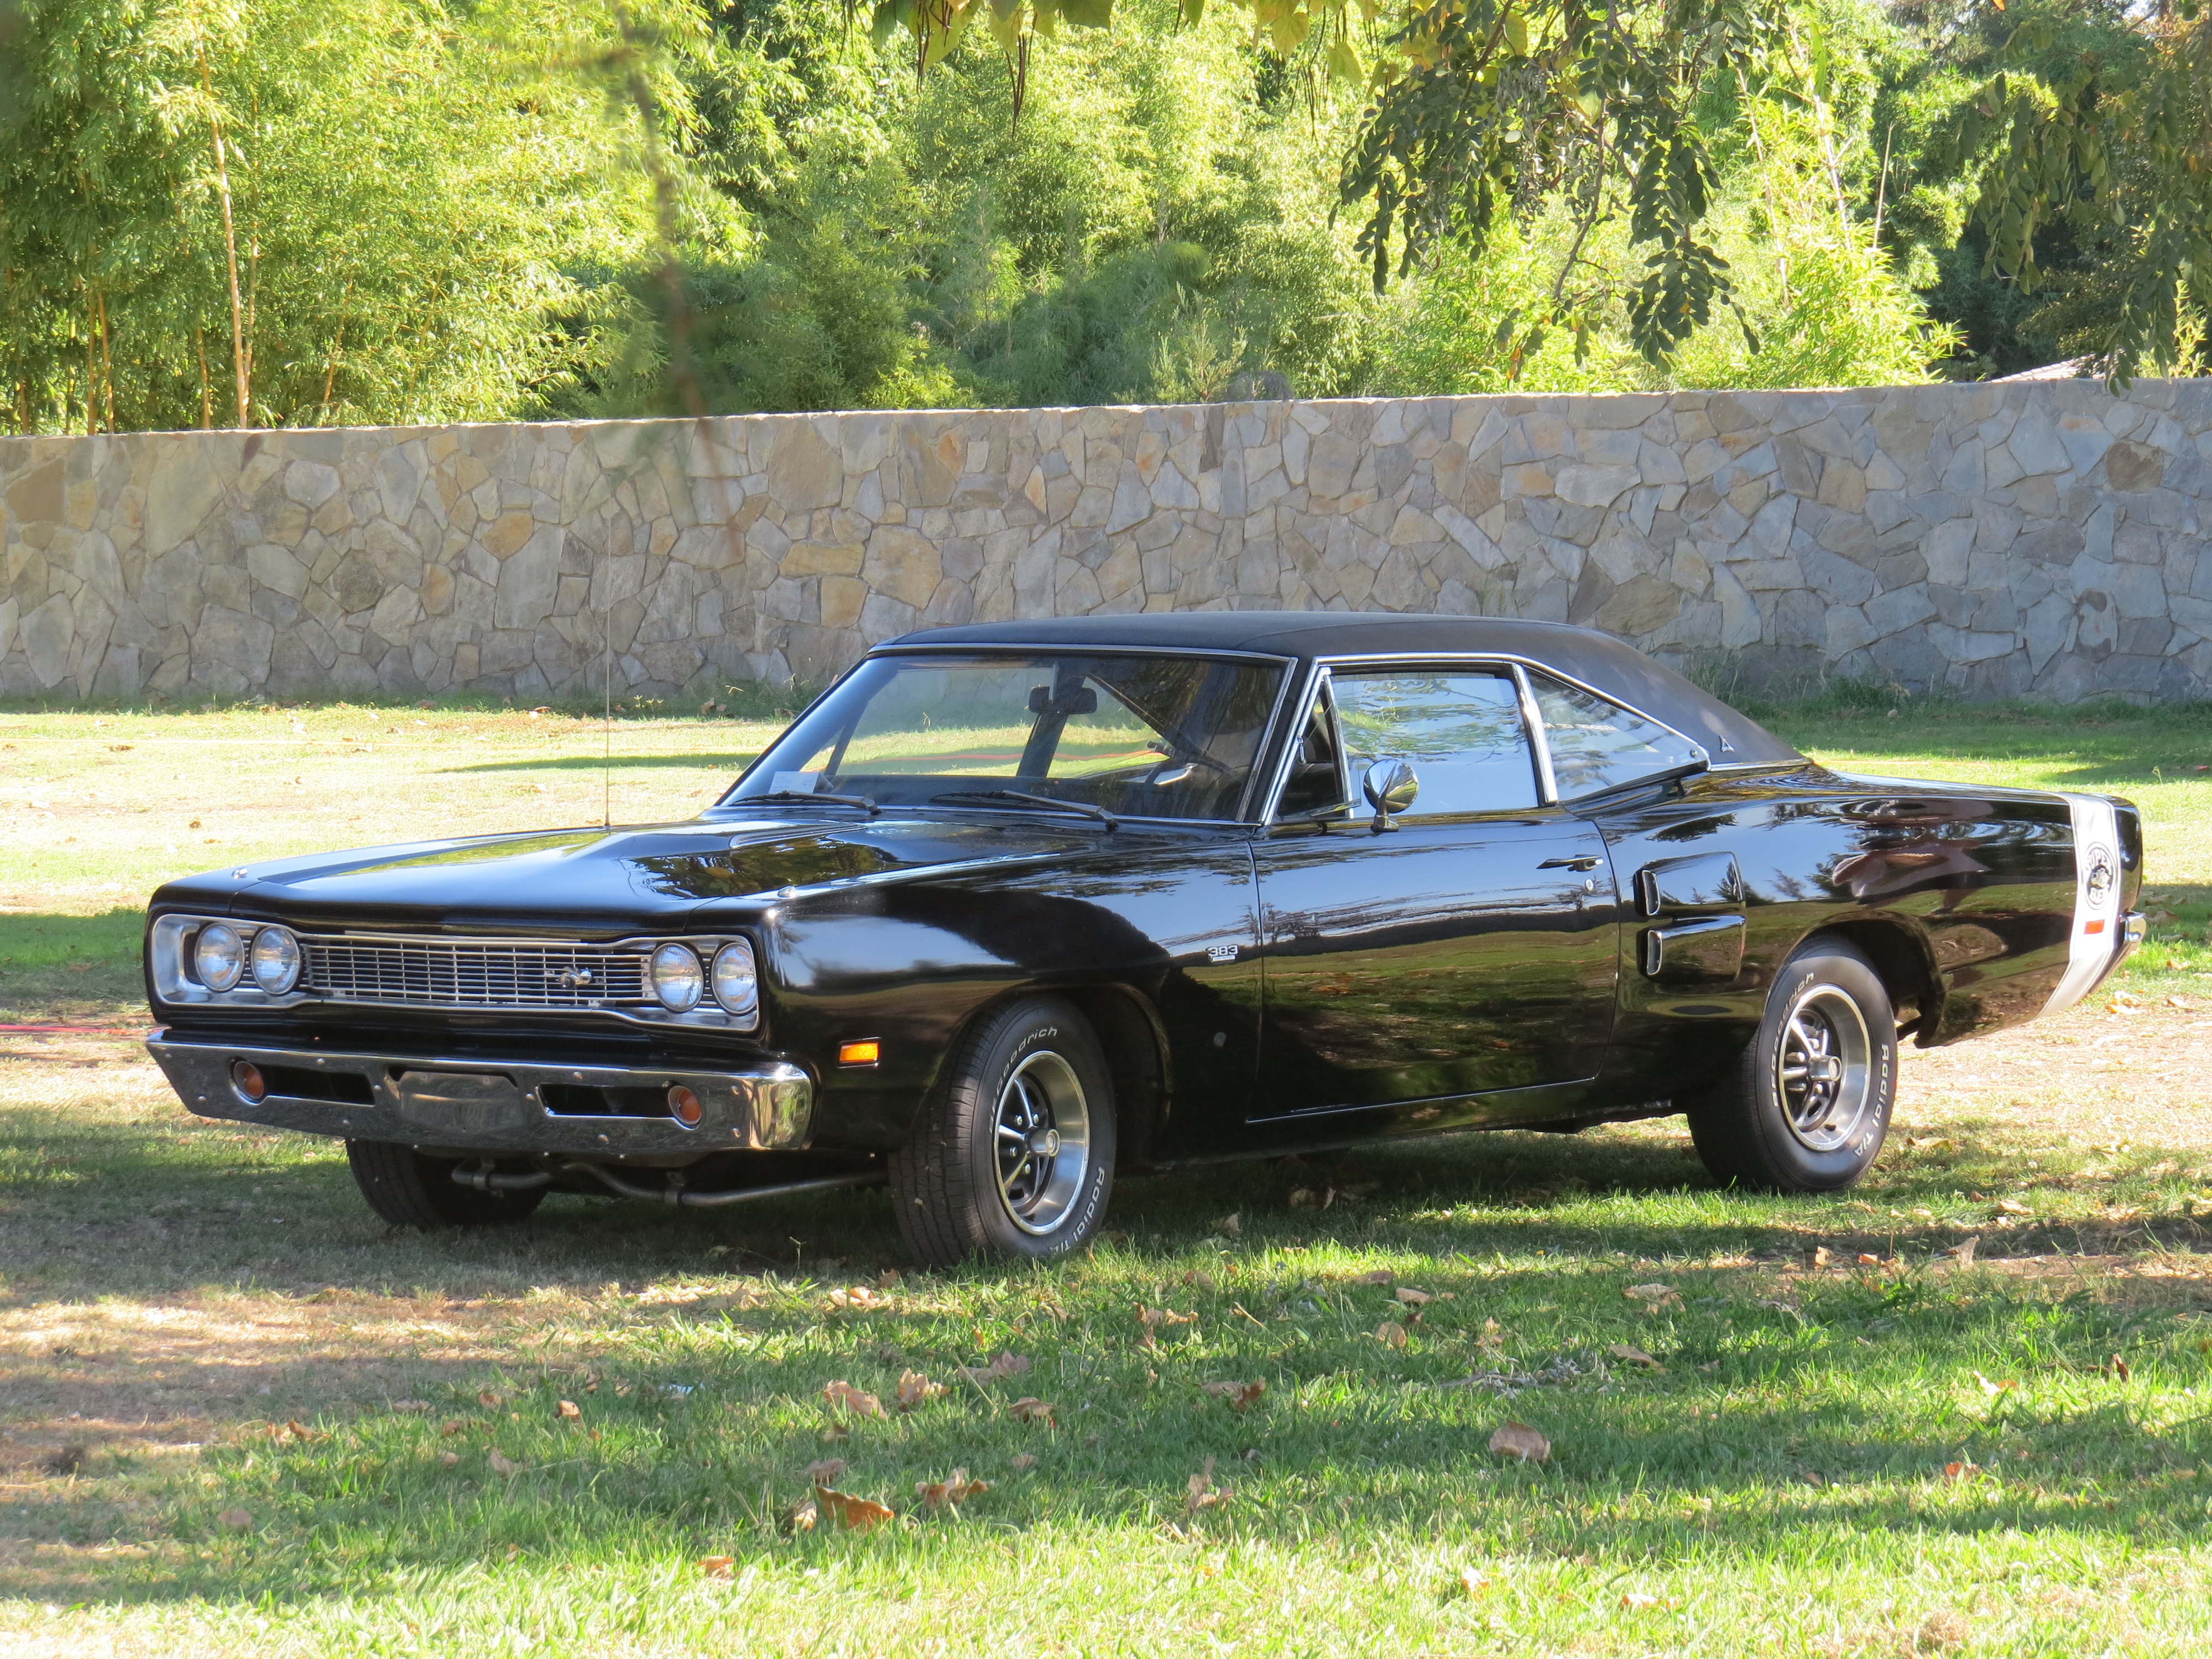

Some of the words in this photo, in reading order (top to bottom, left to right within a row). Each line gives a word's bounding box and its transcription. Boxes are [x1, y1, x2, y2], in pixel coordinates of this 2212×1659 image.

[1207, 945, 1239, 957] 383
[1871, 1044, 1890, 1128] Radial
[1853, 1131, 1874, 1157] T/A
[1073, 1166, 1105, 1242] Radial
